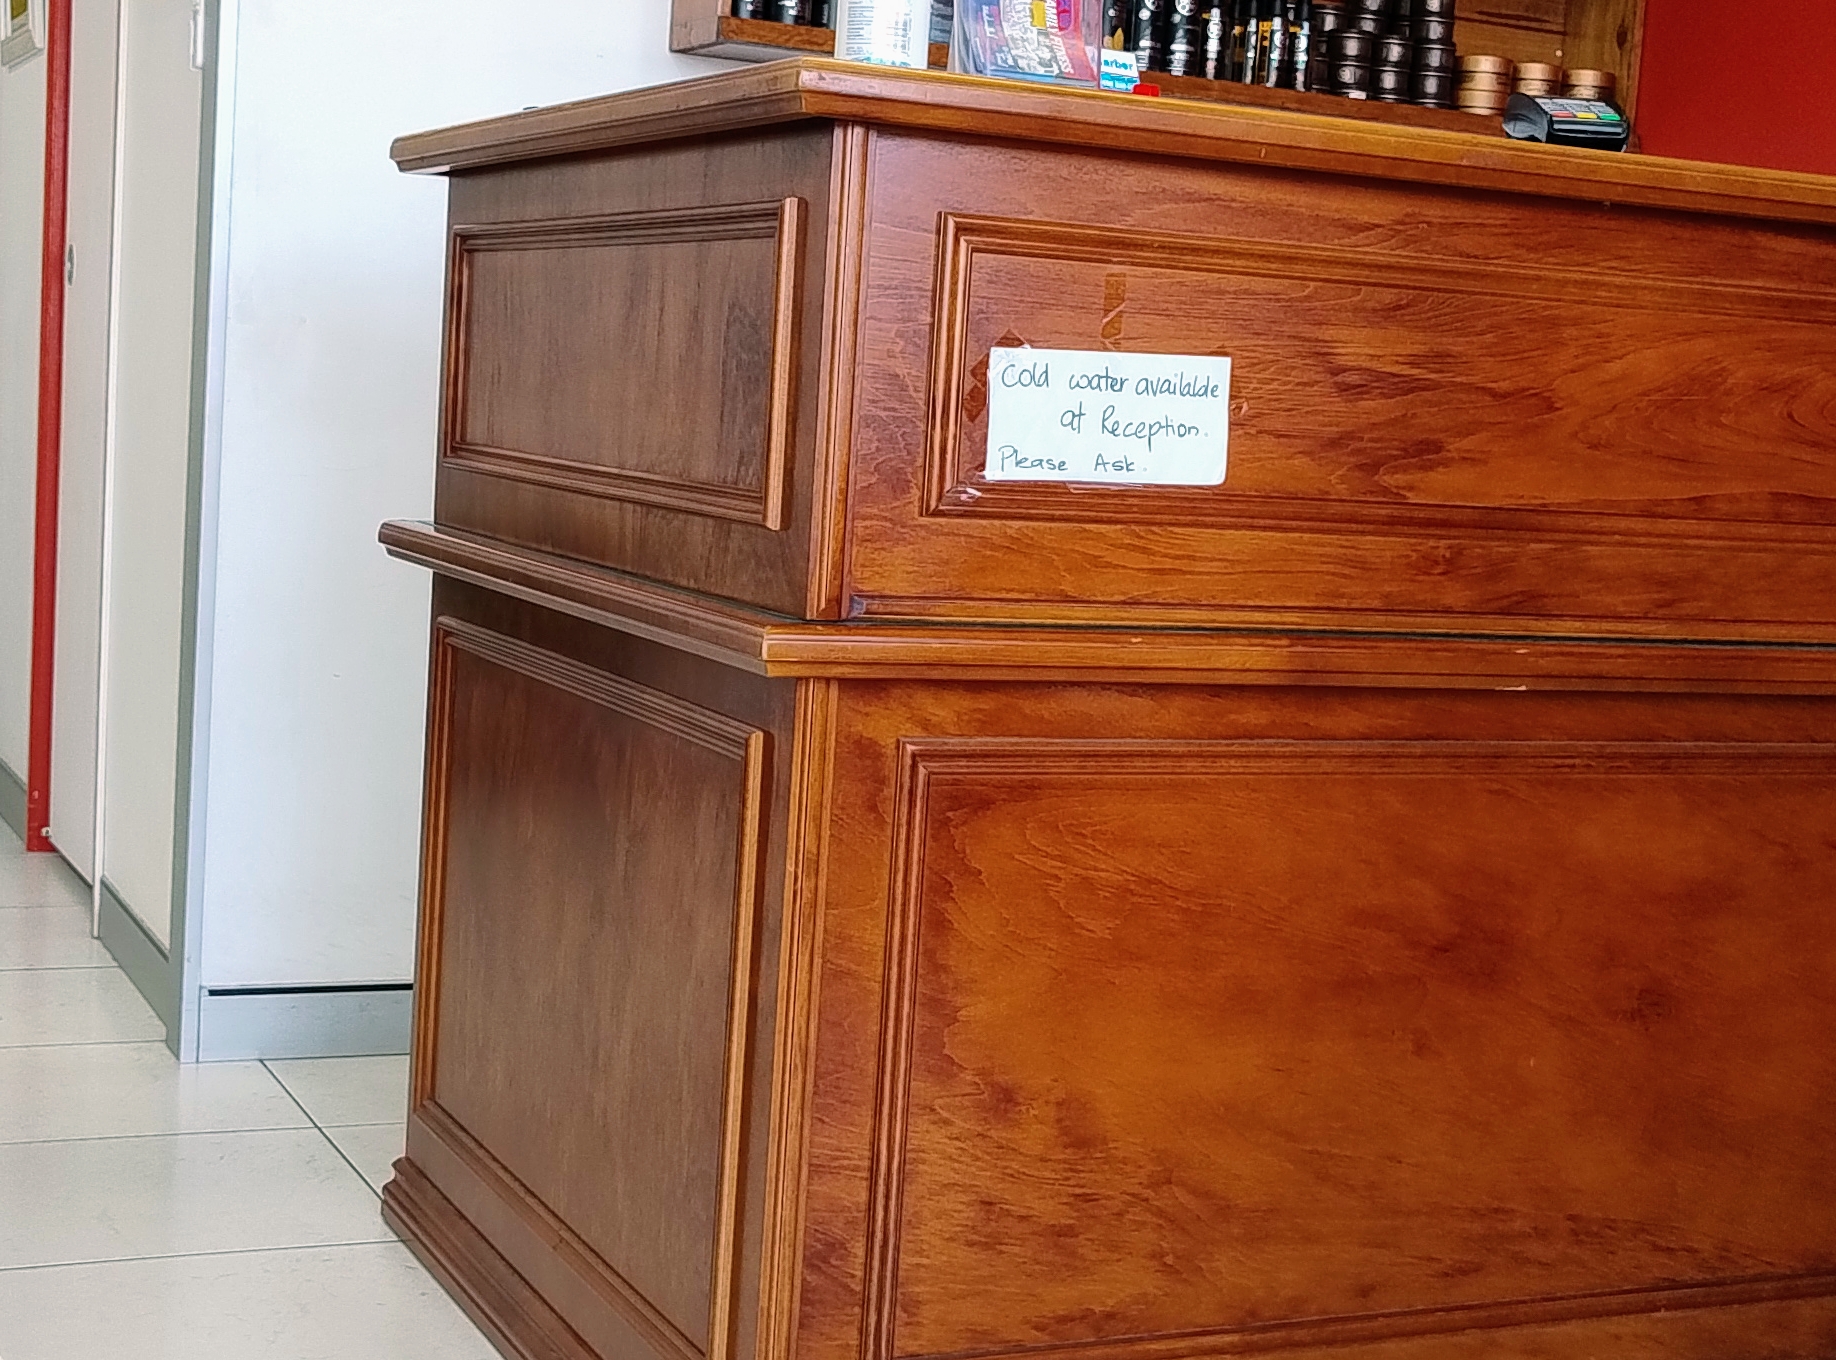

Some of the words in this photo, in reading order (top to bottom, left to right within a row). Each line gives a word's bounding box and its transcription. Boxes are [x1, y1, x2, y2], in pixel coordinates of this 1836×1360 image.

[1049, 33, 1075, 74] FITNESS
[1103, 58, 1134, 71] arber
[1001, 361, 1050, 388] Cold
[1068, 366, 1130, 392] water
[1060, 400, 1087, 434] at
[998, 444, 1069, 473] Please
